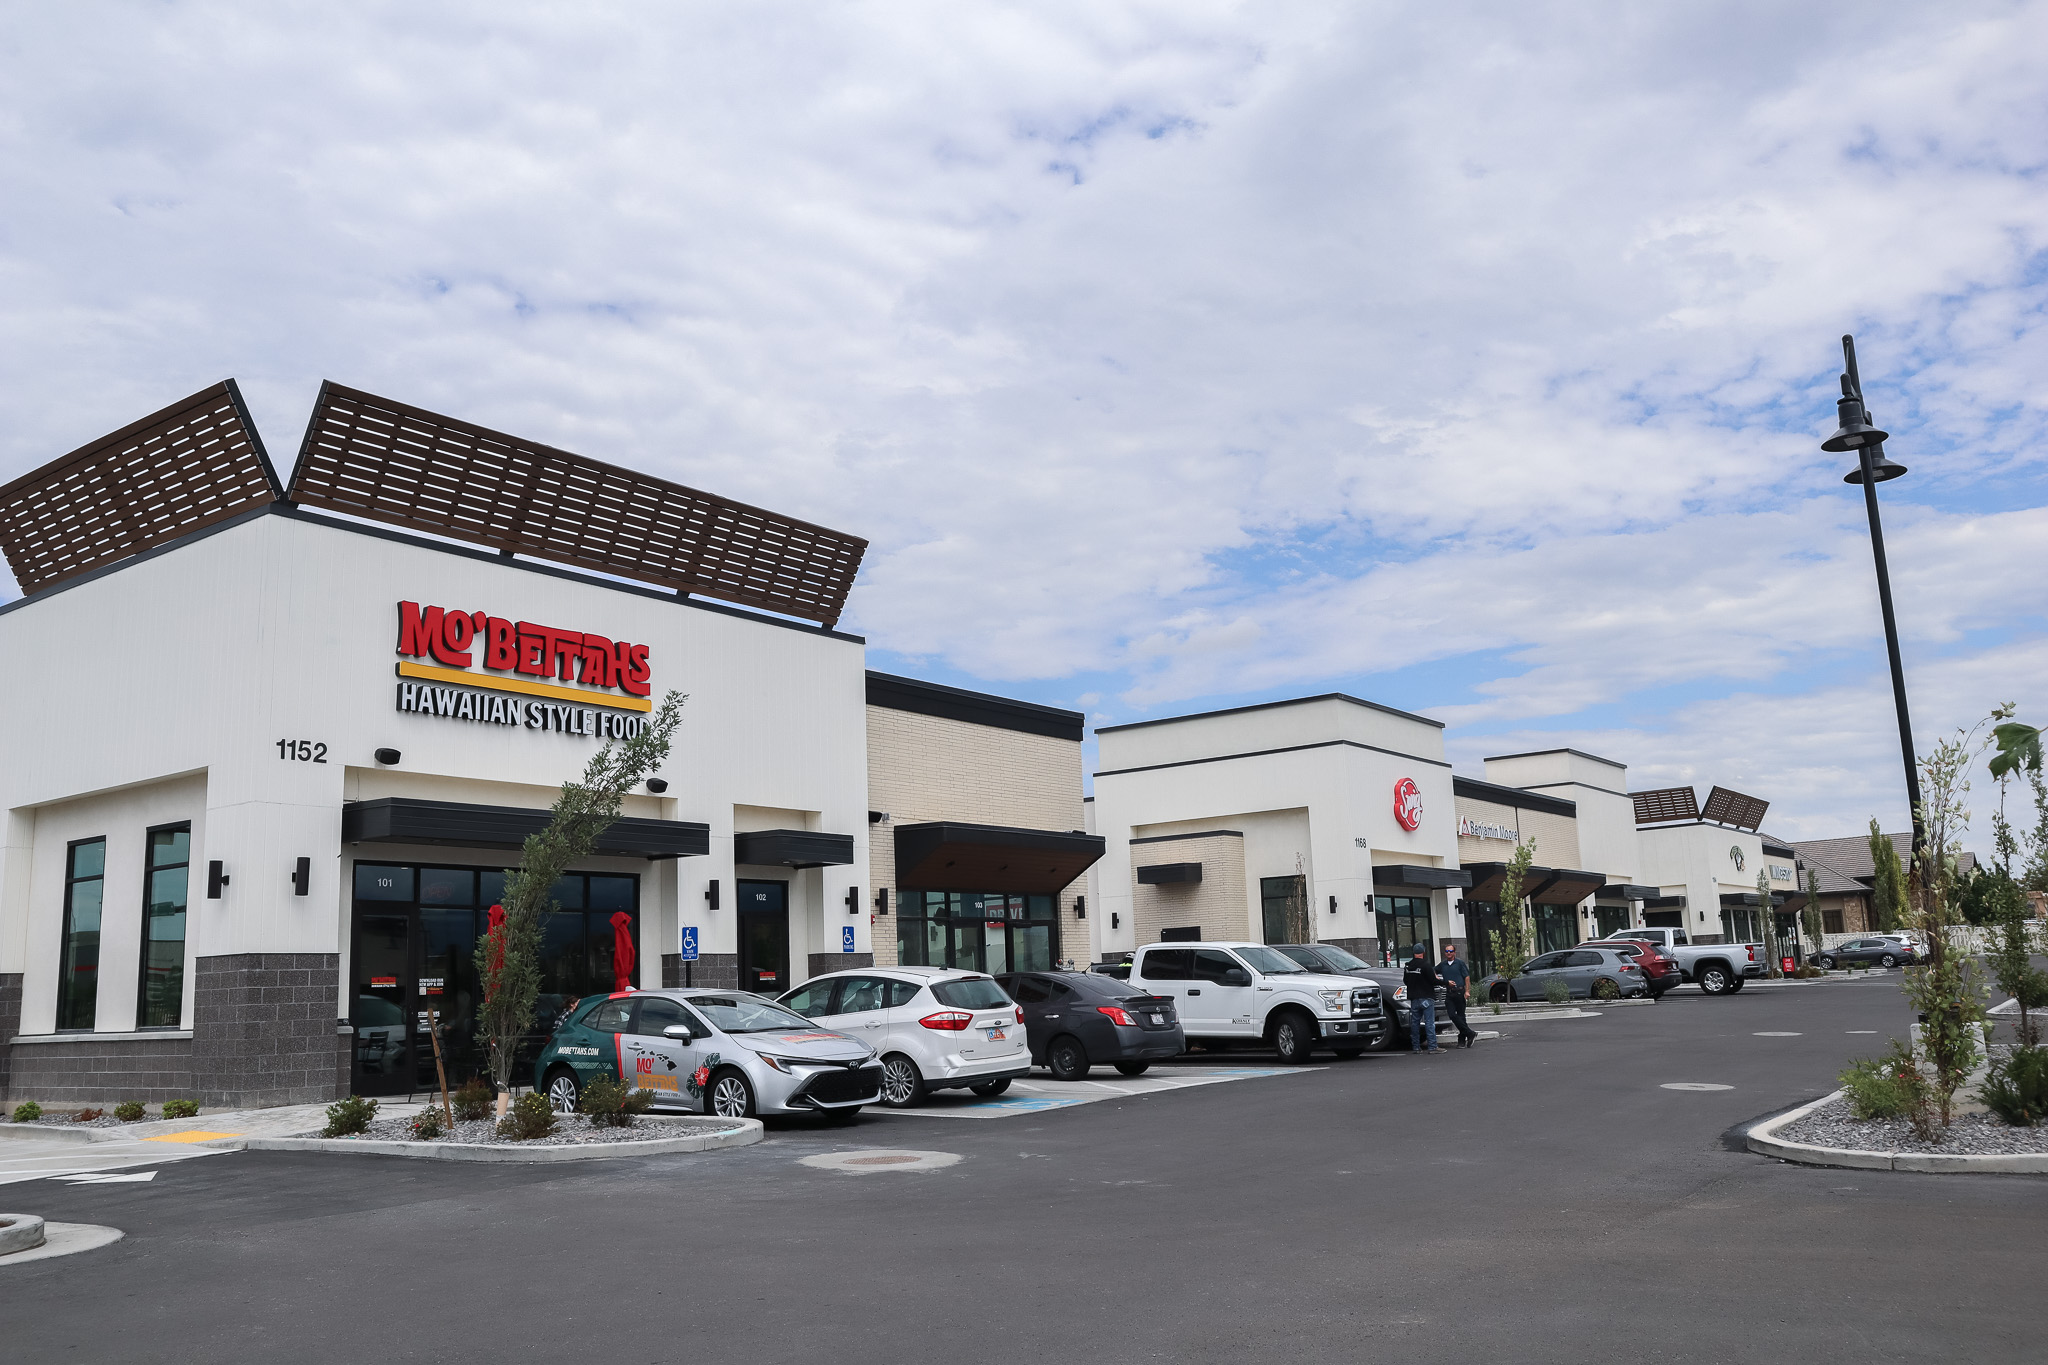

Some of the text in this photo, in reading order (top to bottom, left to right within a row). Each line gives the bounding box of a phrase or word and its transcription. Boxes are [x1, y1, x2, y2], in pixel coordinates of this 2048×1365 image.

[397, 682, 522, 727] HAWAIIAN
[525, 701, 594, 736] STYLE
[276, 738, 328, 764] 1152
[1470, 820, 1518, 841] Benjamin Moore
[377, 878, 393, 887] 101
[755, 893, 767, 901] 102
